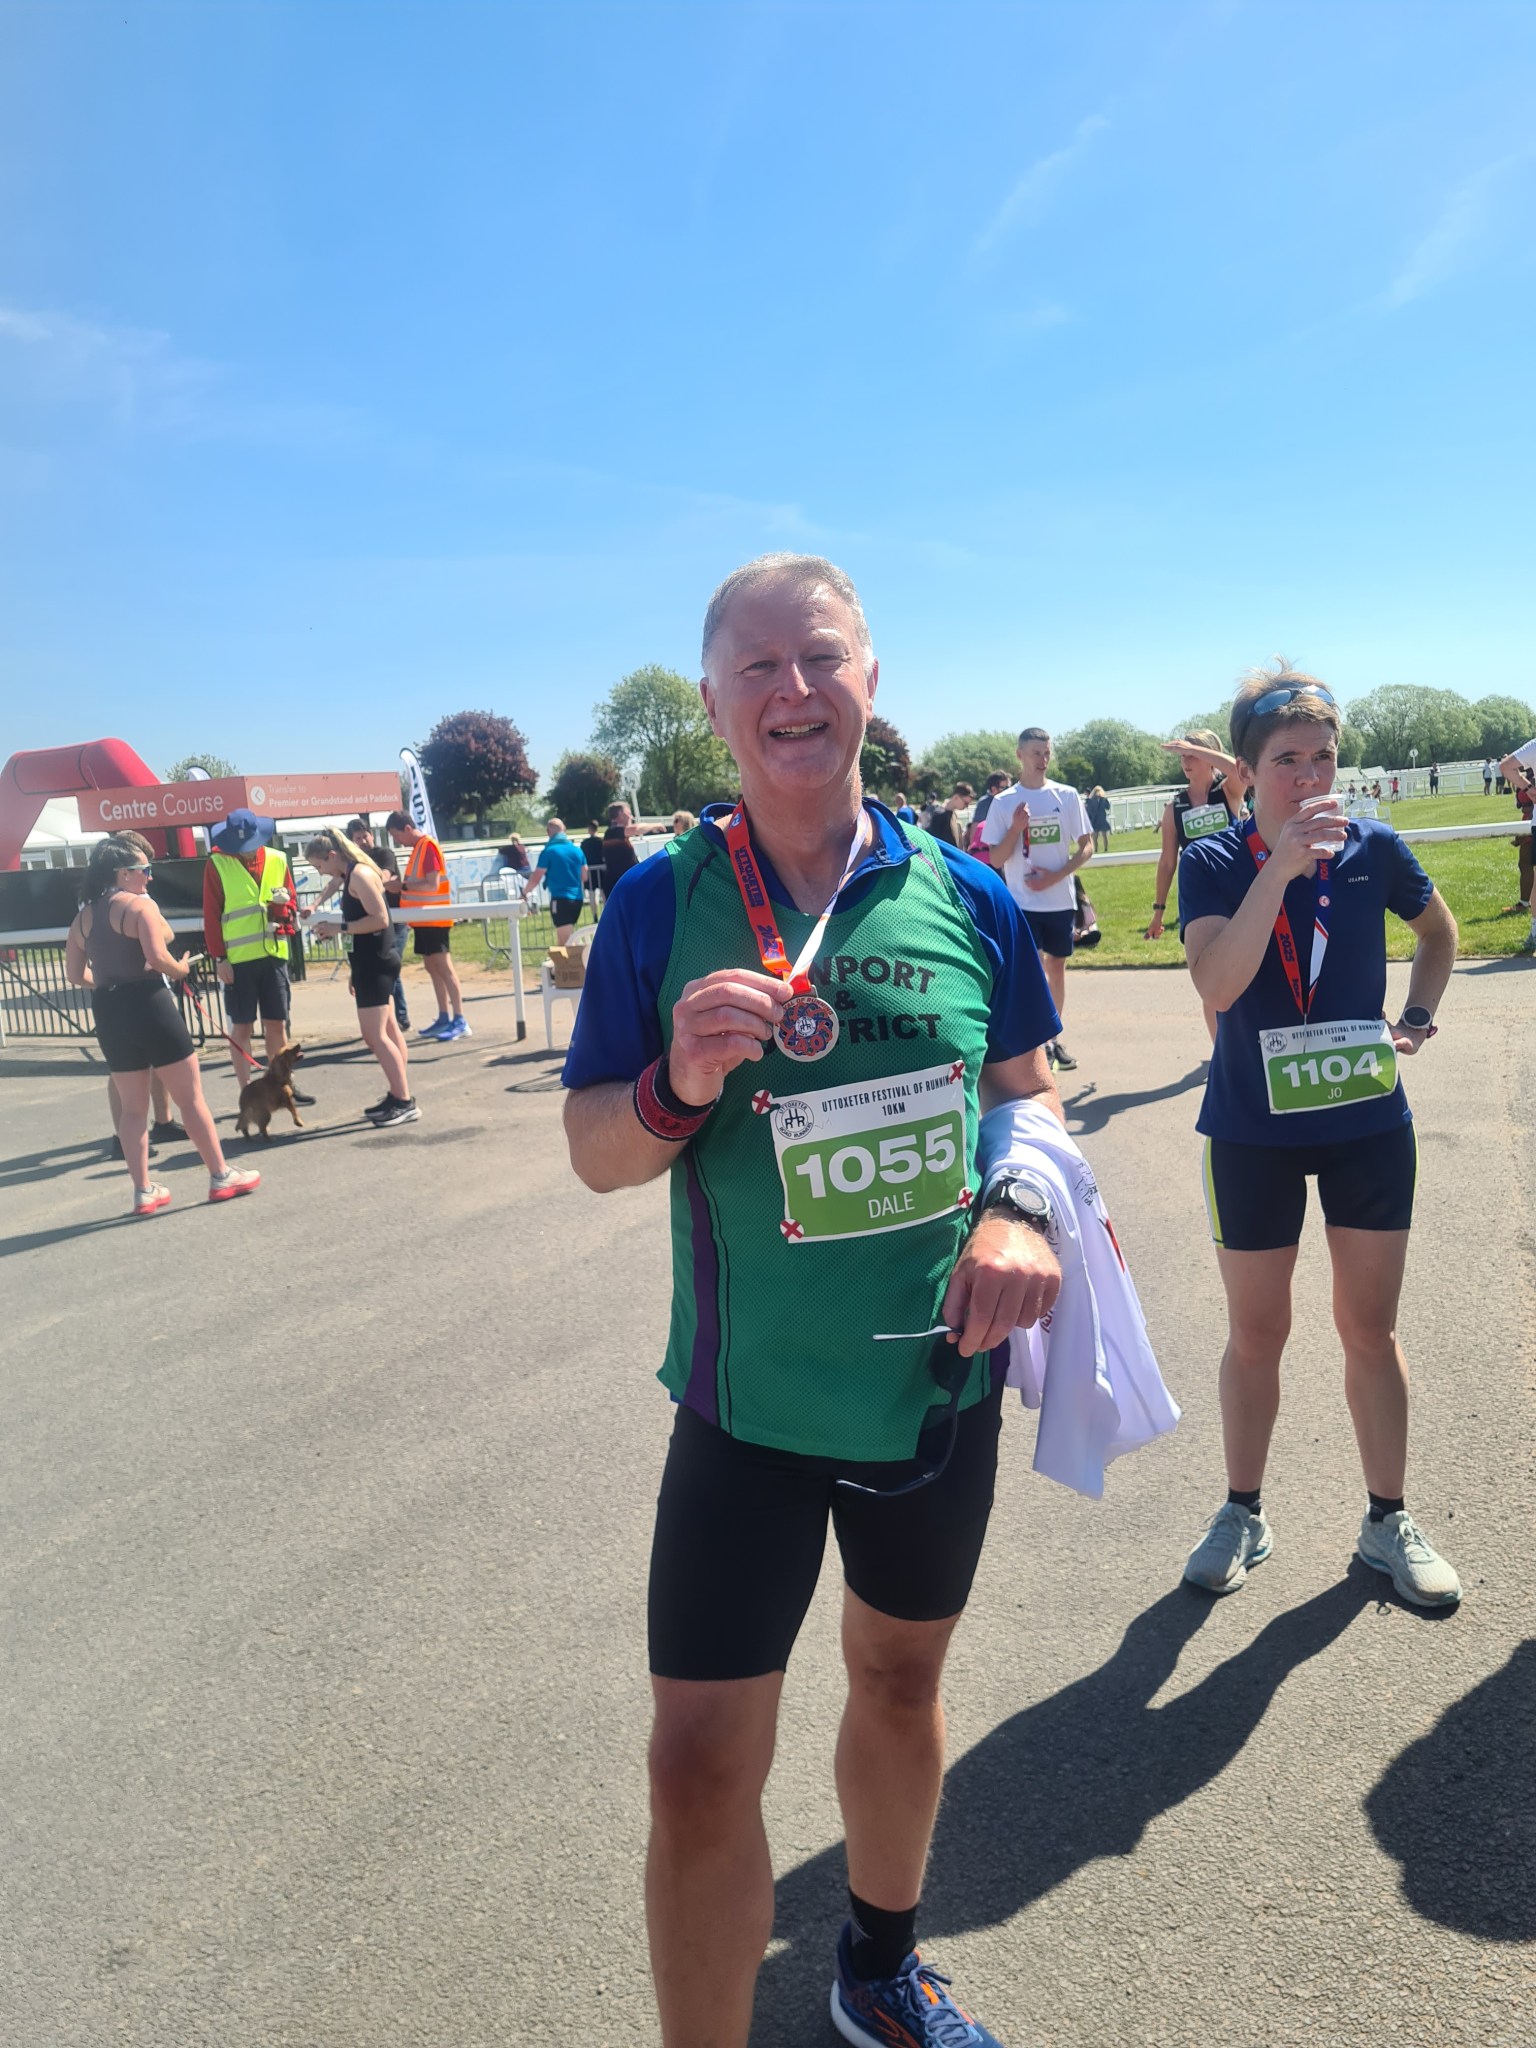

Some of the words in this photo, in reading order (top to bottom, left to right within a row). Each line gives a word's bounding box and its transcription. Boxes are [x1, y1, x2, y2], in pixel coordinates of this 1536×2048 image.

[100, 799, 157, 821] Centre
[162, 793, 223, 816] Course
[269, 798, 298, 808] Premier
[311, 795, 353, 806] Grandstand
[355, 795, 368, 804] and
[369, 793, 398, 804] Paddock
[1186, 812, 1225, 830] 1052
[1030, 826, 1058, 838] 007
[1279, 933, 1295, 963] 2025
[834, 990, 857, 1011] &
[1324, 1025, 1350, 1035] FESTIVAL
[1351, 1024, 1357, 1032] OF
[1282, 1051, 1383, 1088] 1104
[821, 1092, 870, 1113] UTTOXETER
[872, 1083, 911, 1102] FESTIVAL
[913, 1082, 923, 1094] OF
[925, 1074, 950, 1092] RUNNIN
[1327, 1087, 1342, 1100] JO
[881, 1102, 906, 1116] 10KM
[795, 1123, 956, 1199] 1055
[868, 1191, 916, 1219] DALE
